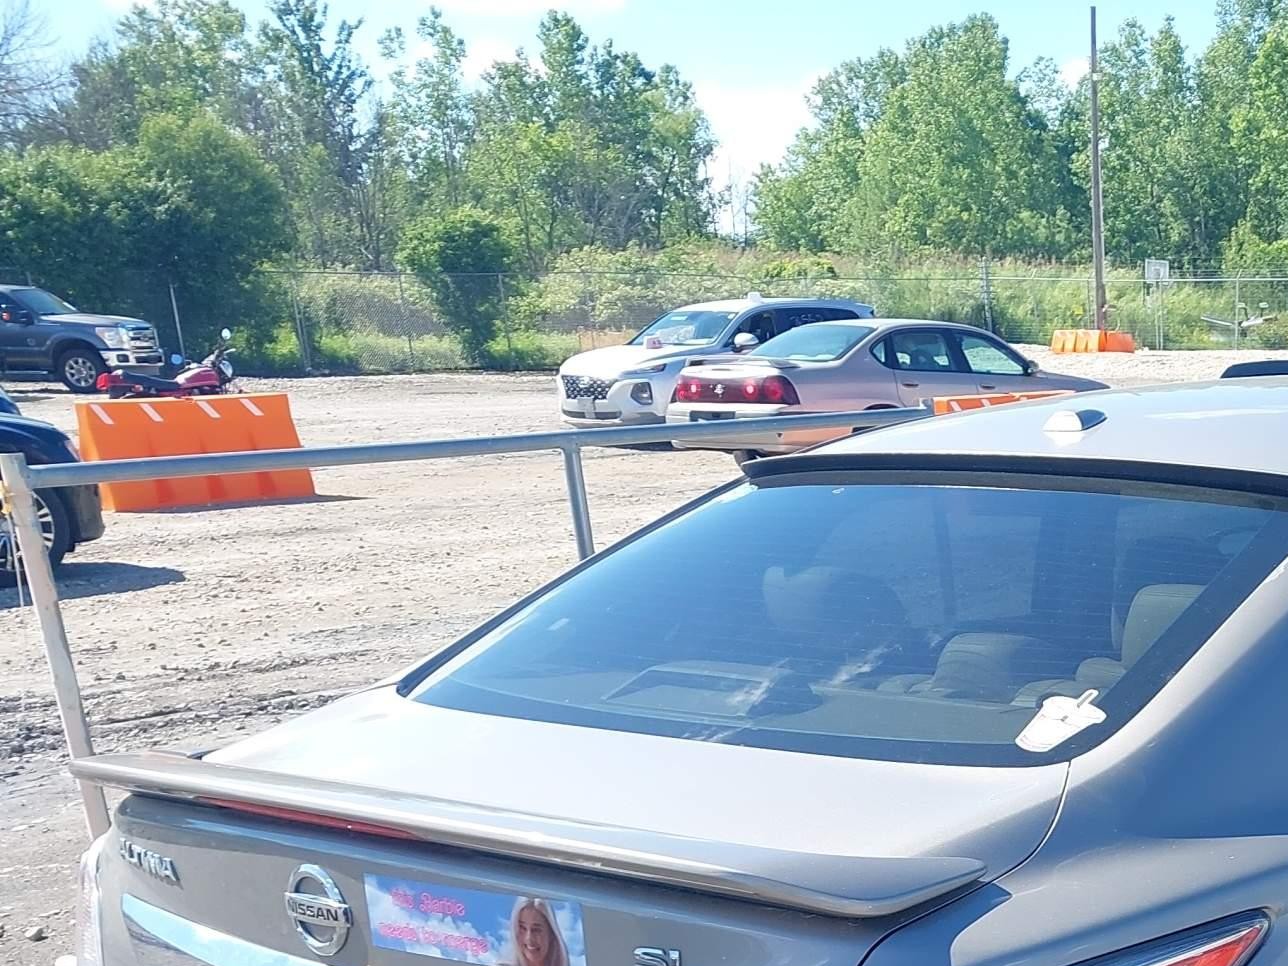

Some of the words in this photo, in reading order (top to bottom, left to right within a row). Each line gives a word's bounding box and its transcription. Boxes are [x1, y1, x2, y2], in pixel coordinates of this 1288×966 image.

[119, 837, 179, 883] ALTIMA
[287, 899, 339, 922] NISSAN
[419, 891, 465, 916] Barbie
